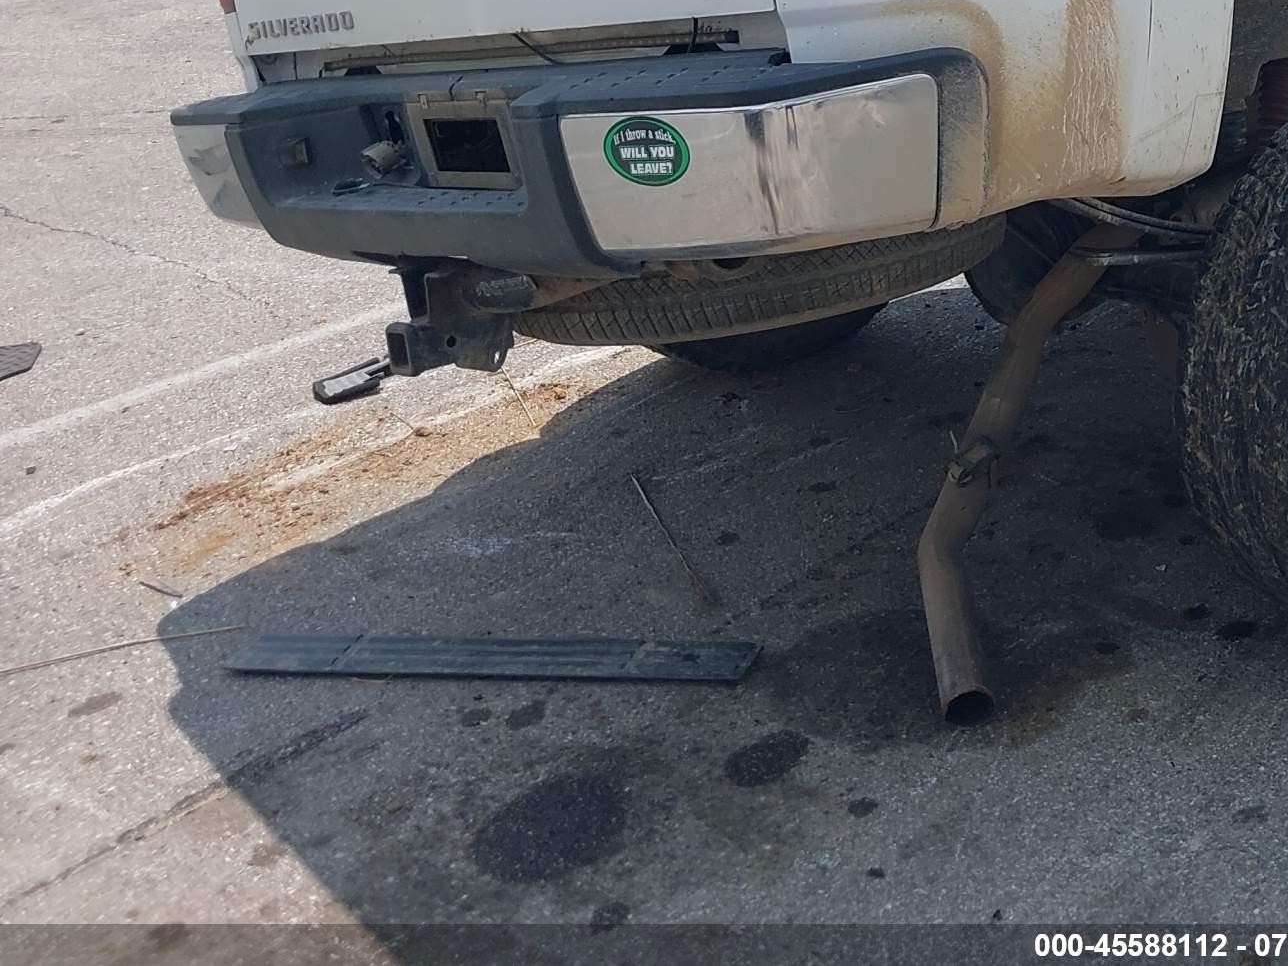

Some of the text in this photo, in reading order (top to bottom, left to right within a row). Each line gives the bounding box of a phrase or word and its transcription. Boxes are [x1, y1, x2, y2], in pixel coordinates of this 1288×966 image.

[247, 11, 355, 39] SILVERADO
[624, 128, 647, 142] throw
[647, 130, 653, 139] a
[620, 146, 674, 159] WILL YOU
[630, 162, 673, 175] LEAVE?
